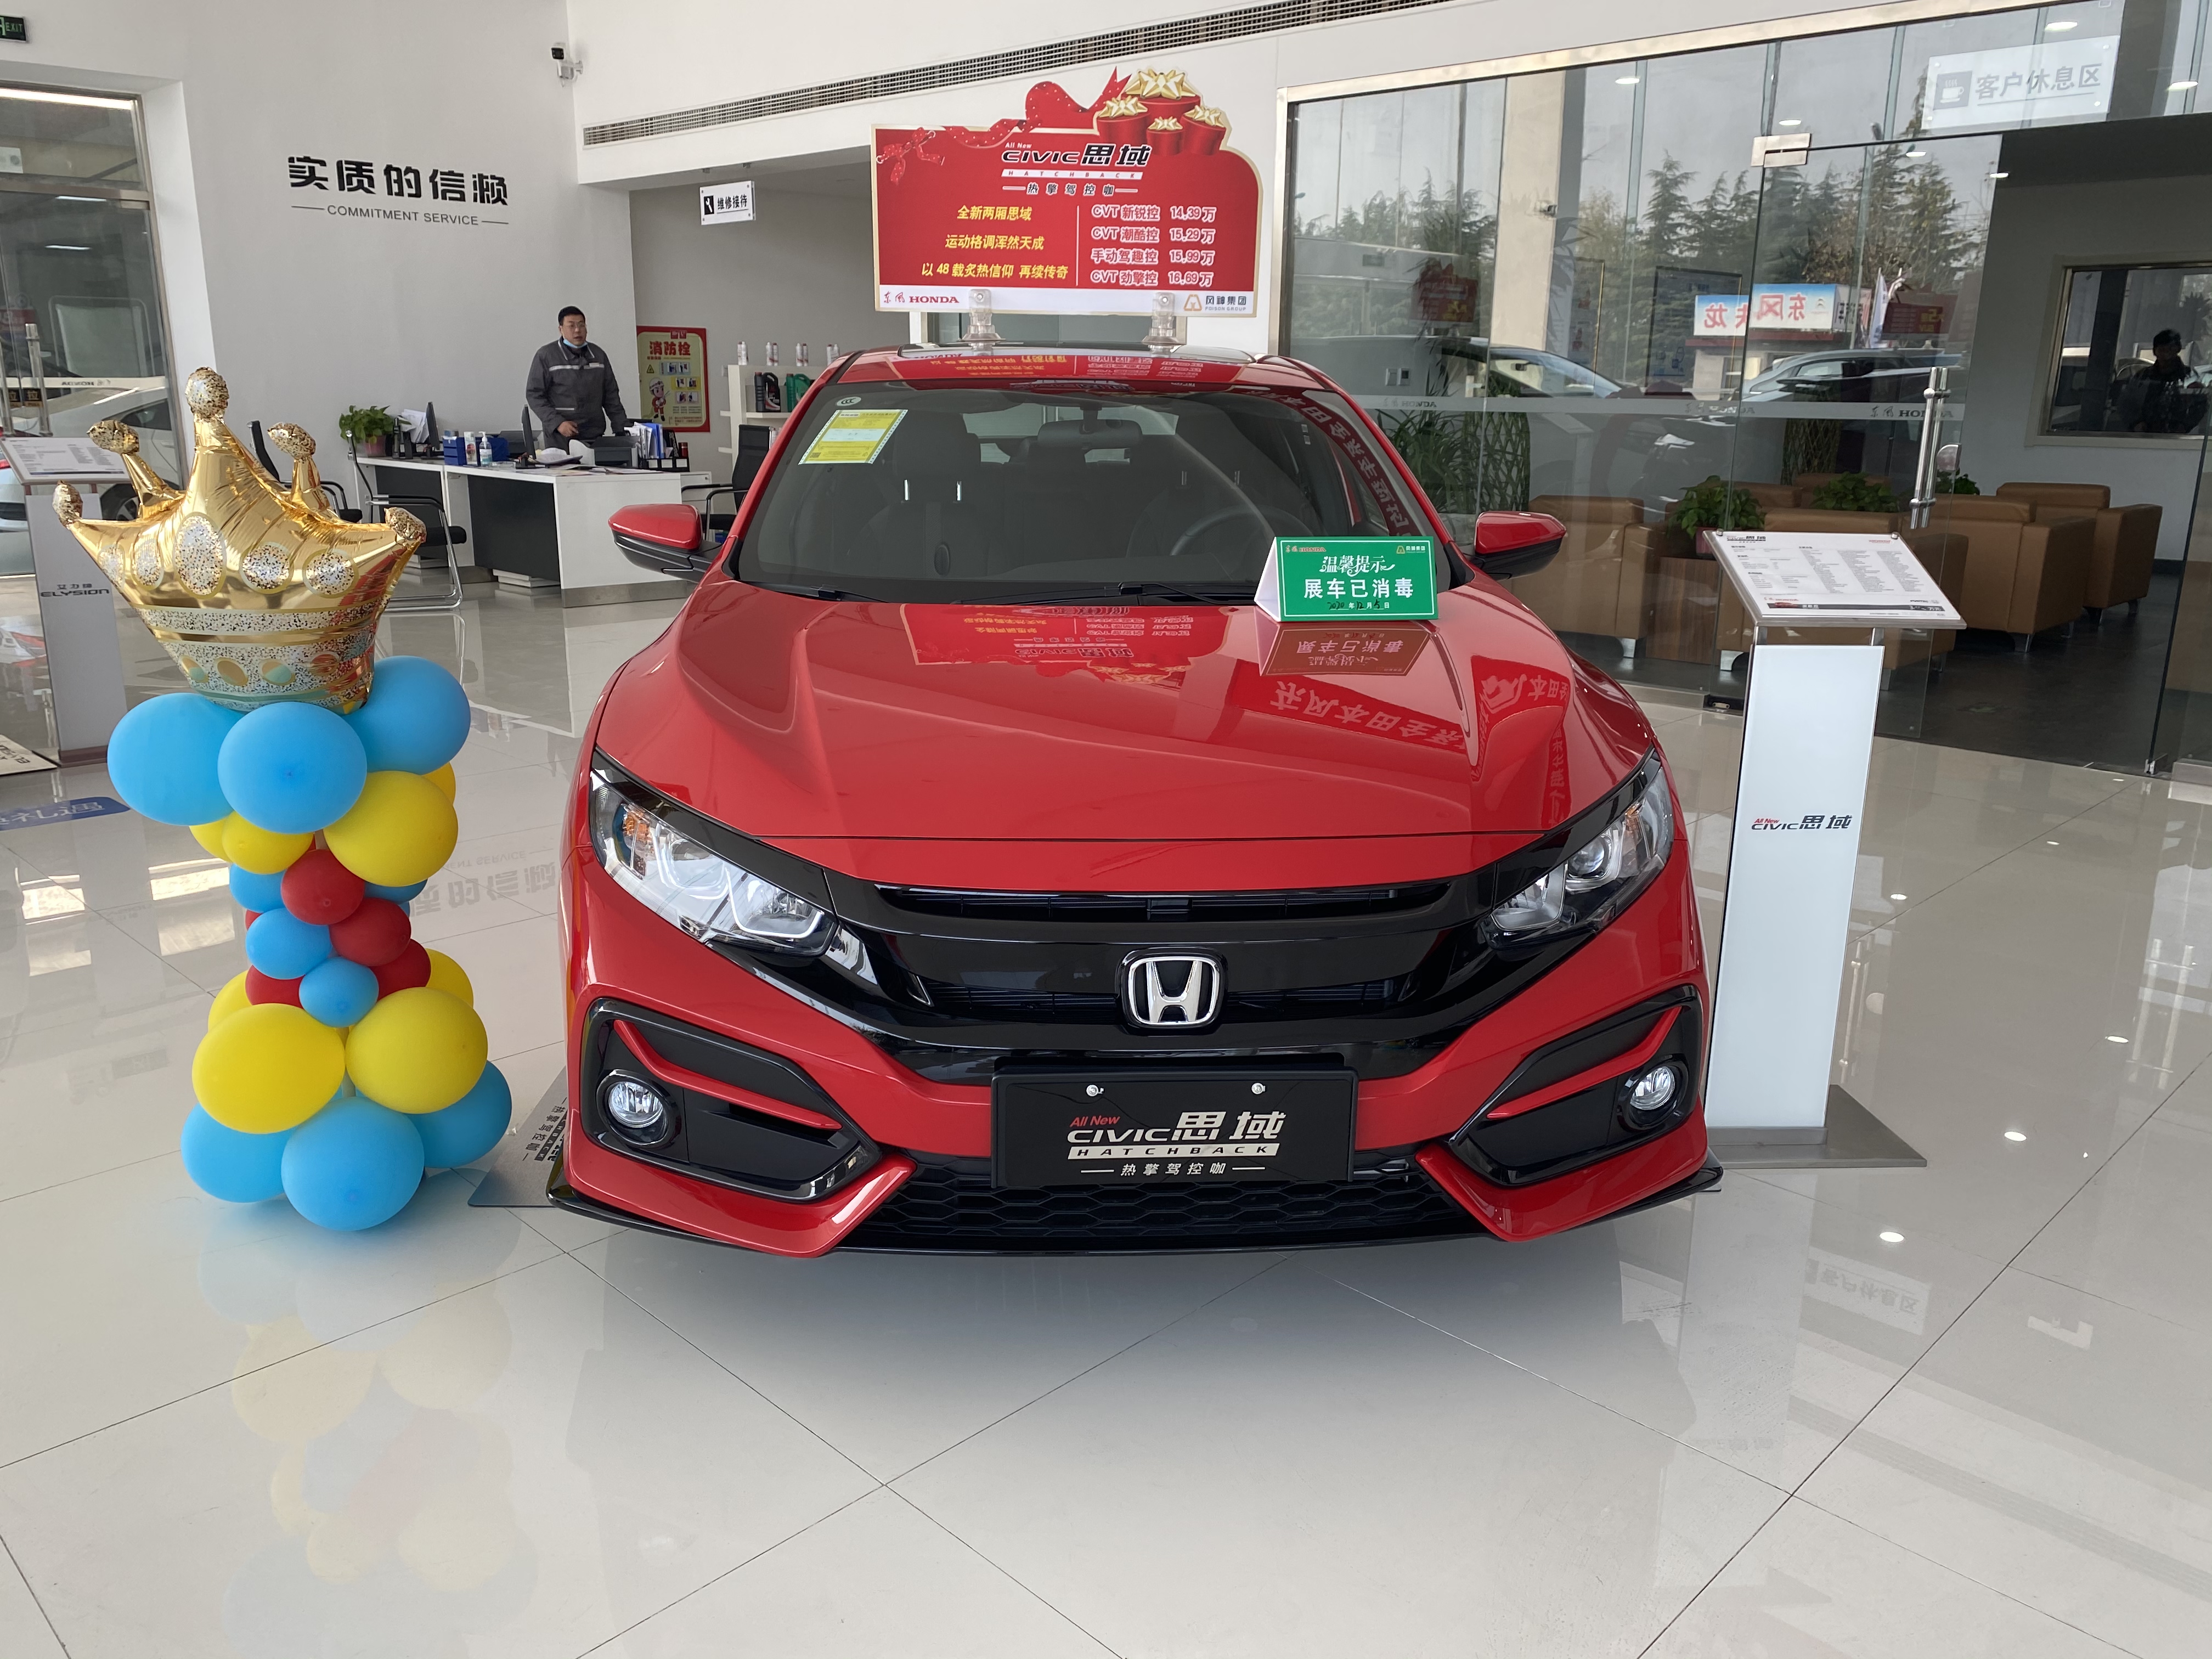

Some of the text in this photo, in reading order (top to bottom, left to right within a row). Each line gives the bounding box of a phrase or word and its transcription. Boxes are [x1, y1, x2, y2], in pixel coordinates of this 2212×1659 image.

[5, 22, 22, 32] EXIT
[1975, 63, 2102, 100] 客户休息区
[1002, 144, 1151, 166] CIVIC 思域
[287, 155, 509, 206] 实质的信赖
[1008, 170, 1135, 179] HATCHBACK
[1027, 183, 1115, 196] 热擎驾控咖
[717, 194, 747, 210] 维修接待
[327, 205, 479, 226] COMMITMENT SERVICE
[956, 205, 1032, 221] 全新两厢思域
[1092, 205, 1216, 222] CVT 新锐控 14.39万
[945, 234, 1045, 250] 运动格调浑然天成
[1091, 227, 1216, 244] CVT 潮酷控 15.29万
[1091, 249, 1215, 266] 手动驾趣控 15.99万
[921, 263, 1069, 279] 以 48 载炙热信仰 再续传奇
[1091, 270, 1214, 287] CVT 劲擎控 16.69万
[1206, 295, 1246, 306] 风神集团
[649, 340, 691, 356] 消防栓
[1319, 555, 1395, 577] 温馨提示
[41, 589, 110, 597] ELYSION
[1304, 578, 1414, 599] 展车已消毒
[1798, 815, 1853, 830] 思域
[1066, 1111, 1287, 1143] CIVIC 思域
[1069, 1115, 1121, 1127] All New
[1077, 1145, 1269, 1156] HATCHBACK
[1120, 1162, 1227, 1177] 热擎驾控咖
